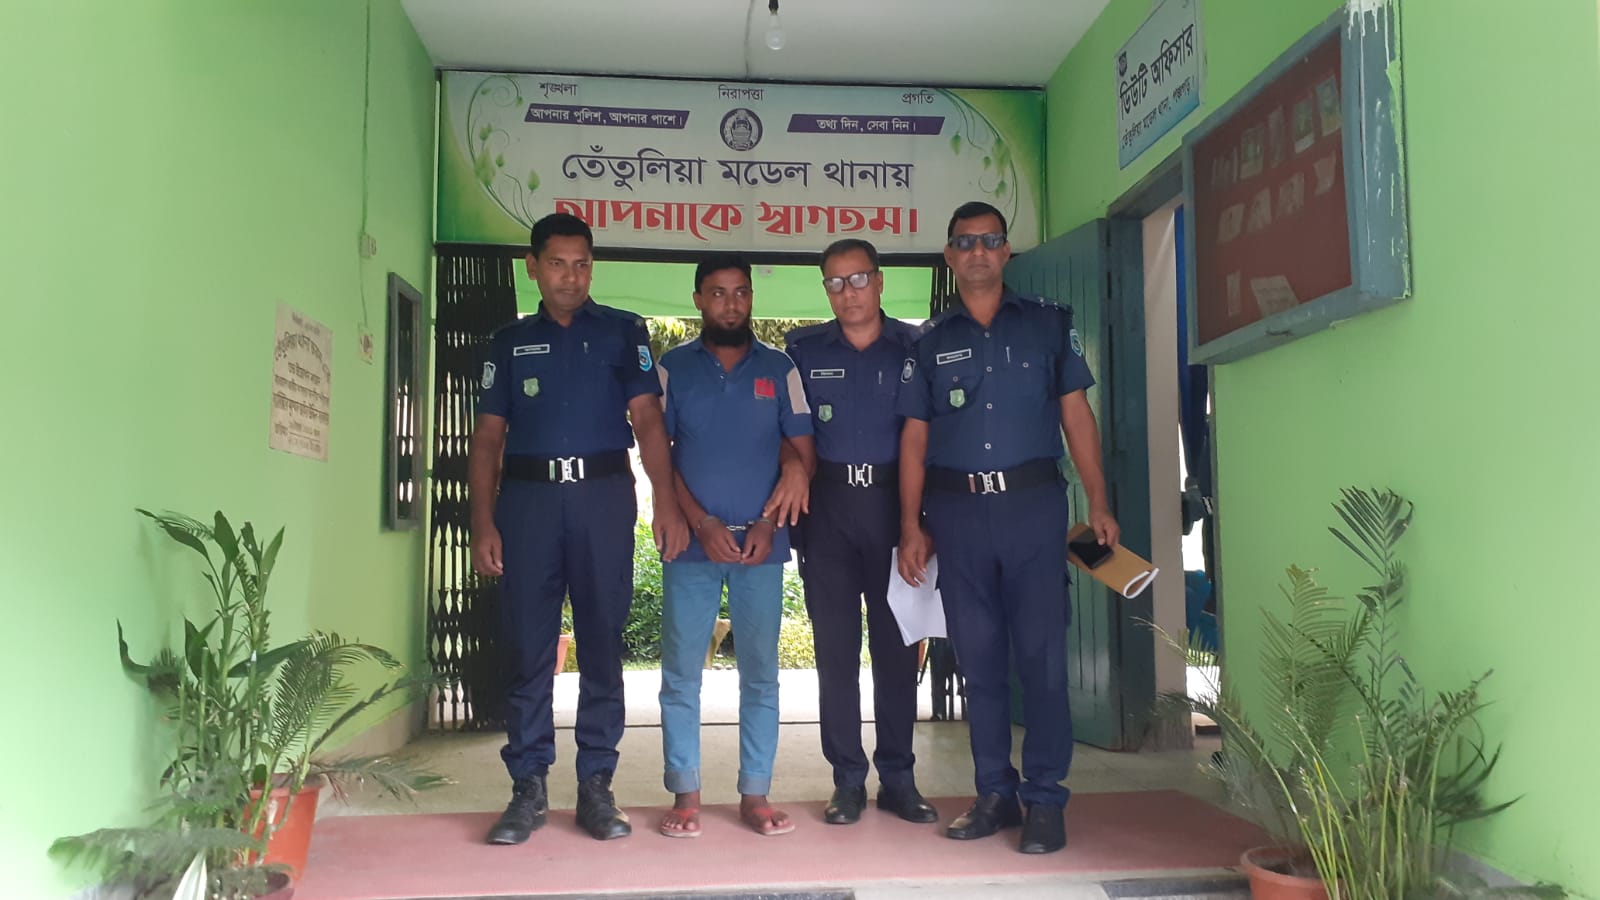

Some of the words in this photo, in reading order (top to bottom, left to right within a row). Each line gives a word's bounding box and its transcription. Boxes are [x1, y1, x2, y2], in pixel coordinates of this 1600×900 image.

[1119, 63, 1148, 120] ডিউটি
[1150, 23, 1194, 87] অফিসার
[718, 84, 764, 101] নিরাপত্তা
[901, 90, 935, 105] প্রগতি
[530, 108, 571, 121] আপনার
[573, 108, 606, 124] পুলিশ,
[609, 112, 648, 124] আপনার
[816, 119, 837, 129] তথ্য
[866, 119, 888, 131] সেবা
[562, 144, 708, 191] তেঁতুলিয়া
[717, 159, 812, 188] মডেল
[823, 160, 914, 189] থানায়
[757, 201, 919, 236] স্বাগতম।
